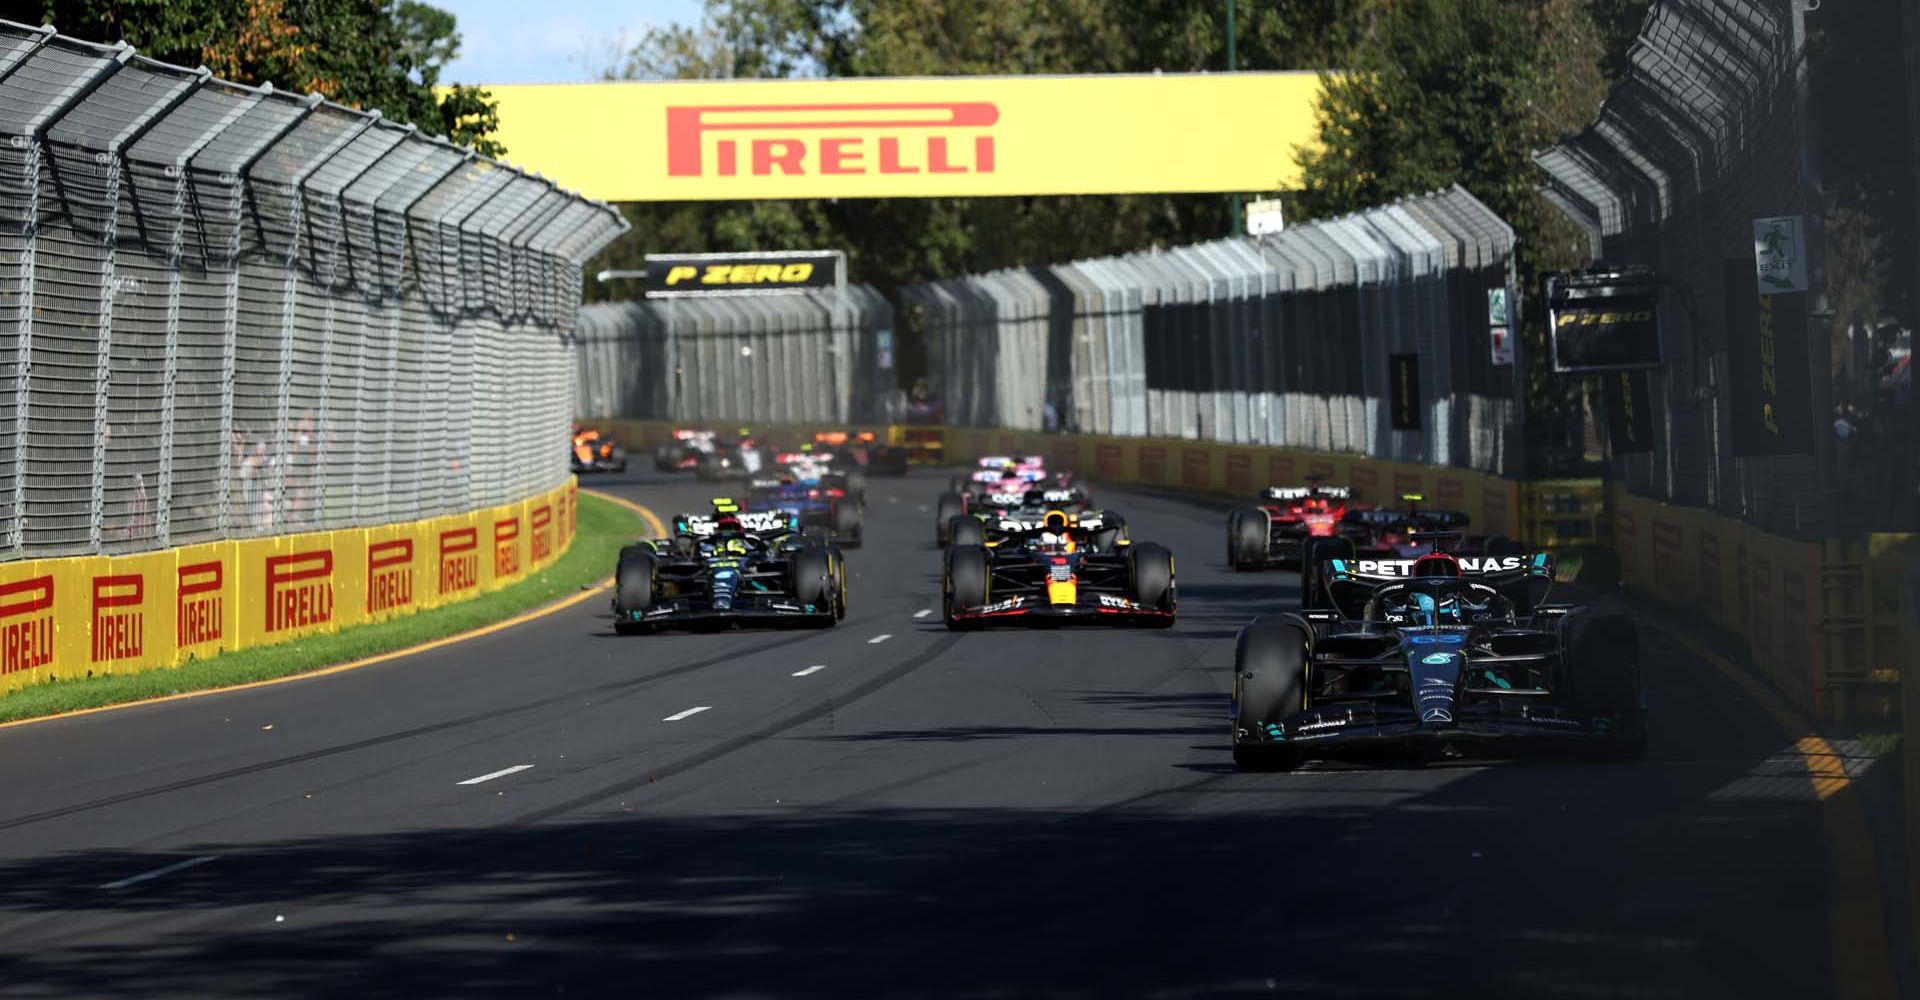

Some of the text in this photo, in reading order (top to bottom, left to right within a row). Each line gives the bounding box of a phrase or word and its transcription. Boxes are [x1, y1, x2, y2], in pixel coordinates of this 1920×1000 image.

[667, 102, 1000, 177] PIRELLI
[665, 262, 814, 286] P ZERO
[1558, 311, 1651, 328] P ZERO
[367, 538, 414, 615] PIRELLI
[438, 527, 478, 596] PIRELLI
[1359, 556, 1521, 576] PETNAS
[92, 574, 144, 663] PIRELLI
[177, 561, 223, 648] PIRELLI
